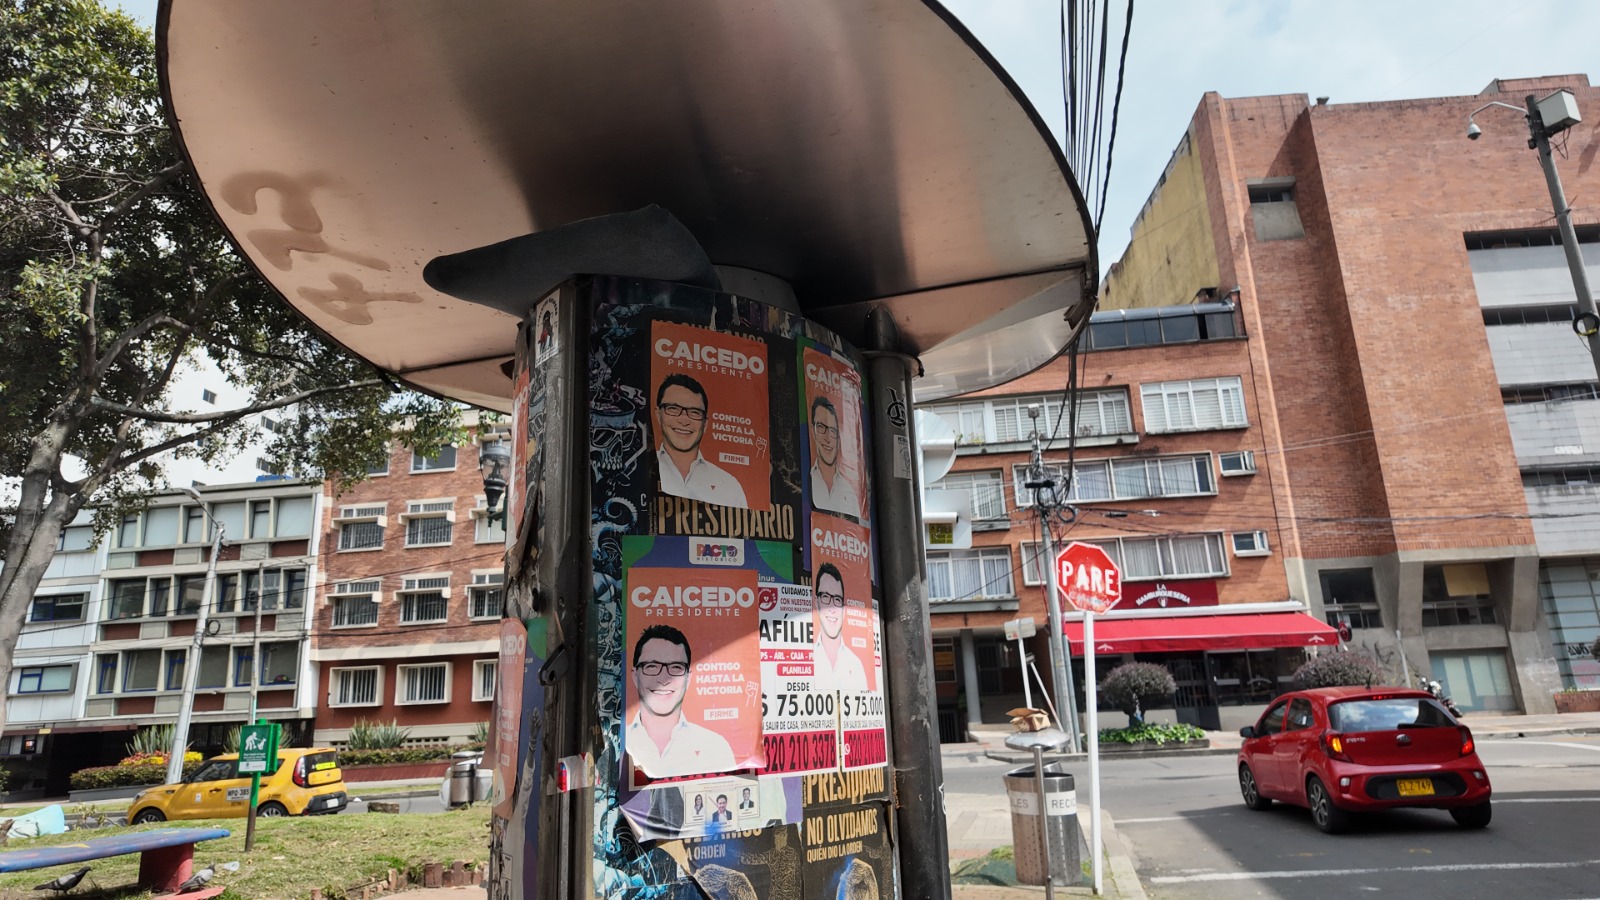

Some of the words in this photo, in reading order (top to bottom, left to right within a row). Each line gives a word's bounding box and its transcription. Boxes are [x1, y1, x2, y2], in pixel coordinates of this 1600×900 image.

[655, 338, 765, 375] CAICEDO
[668, 359, 752, 380] PRESIDENTE
[712, 412, 752, 426] CONTIGO
[712, 422, 743, 435] HASTA
[743, 427, 755, 437] LA
[712, 432, 754, 446] VICTORIA
[723, 454, 746, 464] FIRME
[658, 495, 795, 541] PRESIDIARIO
[812, 527, 869, 559] CAICEDO
[696, 543, 738, 558] PACTO
[1062, 560, 1117, 597] PARE
[631, 586, 755, 608] CAICEDO
[781, 586, 809, 597] CUIDAMOS
[780, 597, 791, 605] CON
[791, 598, 812, 607] NUESTROS
[645, 608, 741, 617] PRESIDENTE
[773, 651, 785, 660] ARL
[790, 651, 805, 661] CAJA
[696, 662, 741, 672] CONTIGO
[782, 666, 812, 675] PLANILLAS
[695, 673, 731, 684] HASTA
[731, 673, 745, 682] LA
[695, 685, 743, 696] VICTORIA
[786, 682, 810, 691] DESDE
[776, 694, 834, 716] 75.000
[844, 695, 851, 719] $
[854, 695, 884, 716] 75.000
[709, 709, 734, 718] FIRME
[780, 720, 786, 730] DE
[763, 735, 785, 773] 320
[788, 734, 808, 771] 210
[812, 732, 836, 769] 3378
[806, 816, 824, 846] NO
[826, 808, 878, 843] OLVIDAMOS
[693, 843, 727, 860] ORDEN
[807, 845, 828, 864] QUIÉN
[827, 845, 838, 859] DIO
[838, 843, 847, 858] LA
[846, 840, 863, 855] ORDEN
